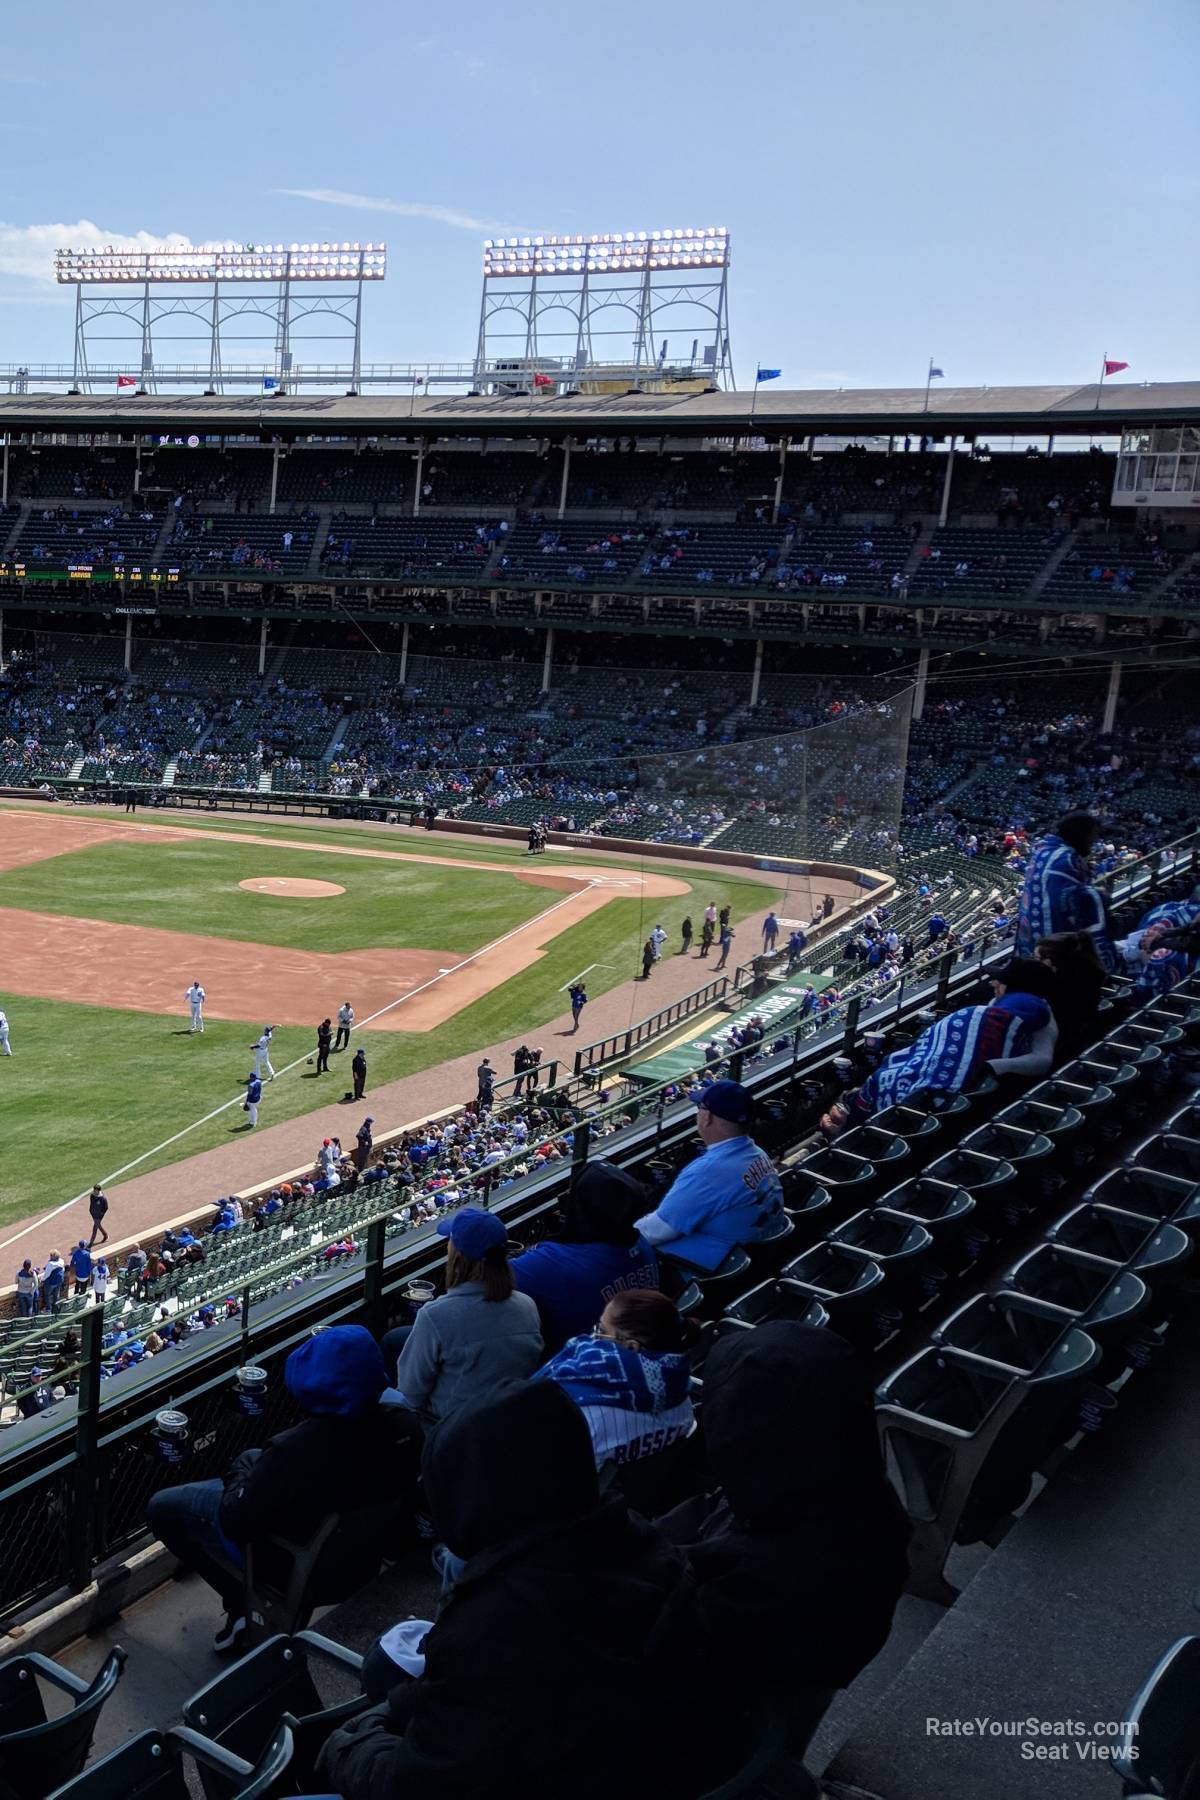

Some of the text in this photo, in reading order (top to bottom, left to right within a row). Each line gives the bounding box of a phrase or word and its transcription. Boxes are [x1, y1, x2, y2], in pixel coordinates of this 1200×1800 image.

[754, 994, 798, 1015] CUBS
[877, 1046, 911, 1111] UBS
[895, 1027, 932, 1104] CHICAGO
